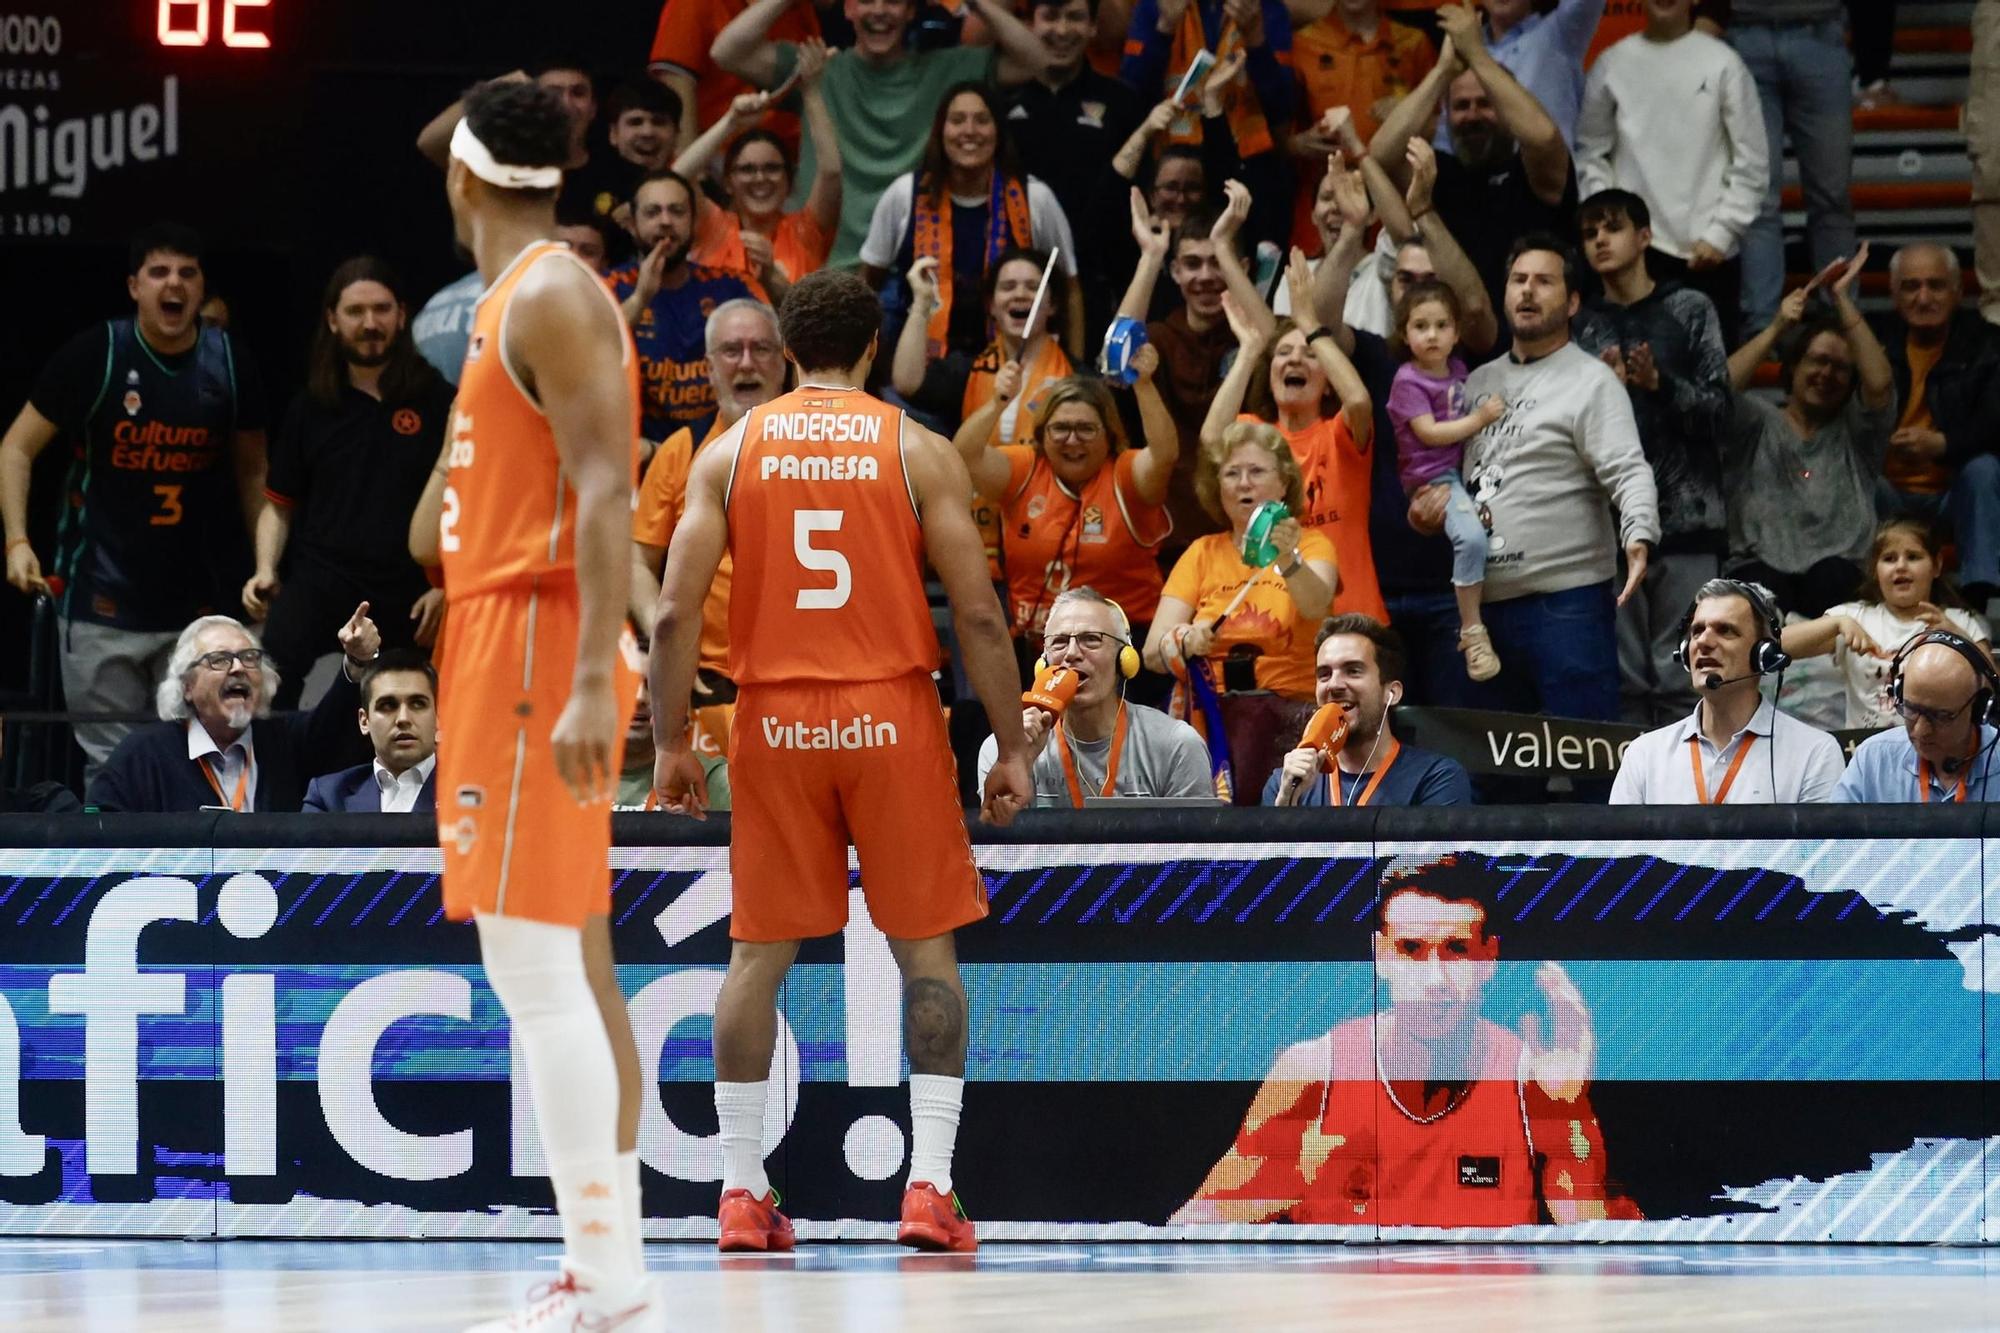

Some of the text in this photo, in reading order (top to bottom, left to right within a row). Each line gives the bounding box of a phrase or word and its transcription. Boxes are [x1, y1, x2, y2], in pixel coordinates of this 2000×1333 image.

[762, 412, 882, 444] ANDERSON
[760, 454, 879, 481] PAMESA
[150, 484, 183, 526] 3
[793, 509, 852, 610] 5
[0, 868, 906, 1183] ficó!
